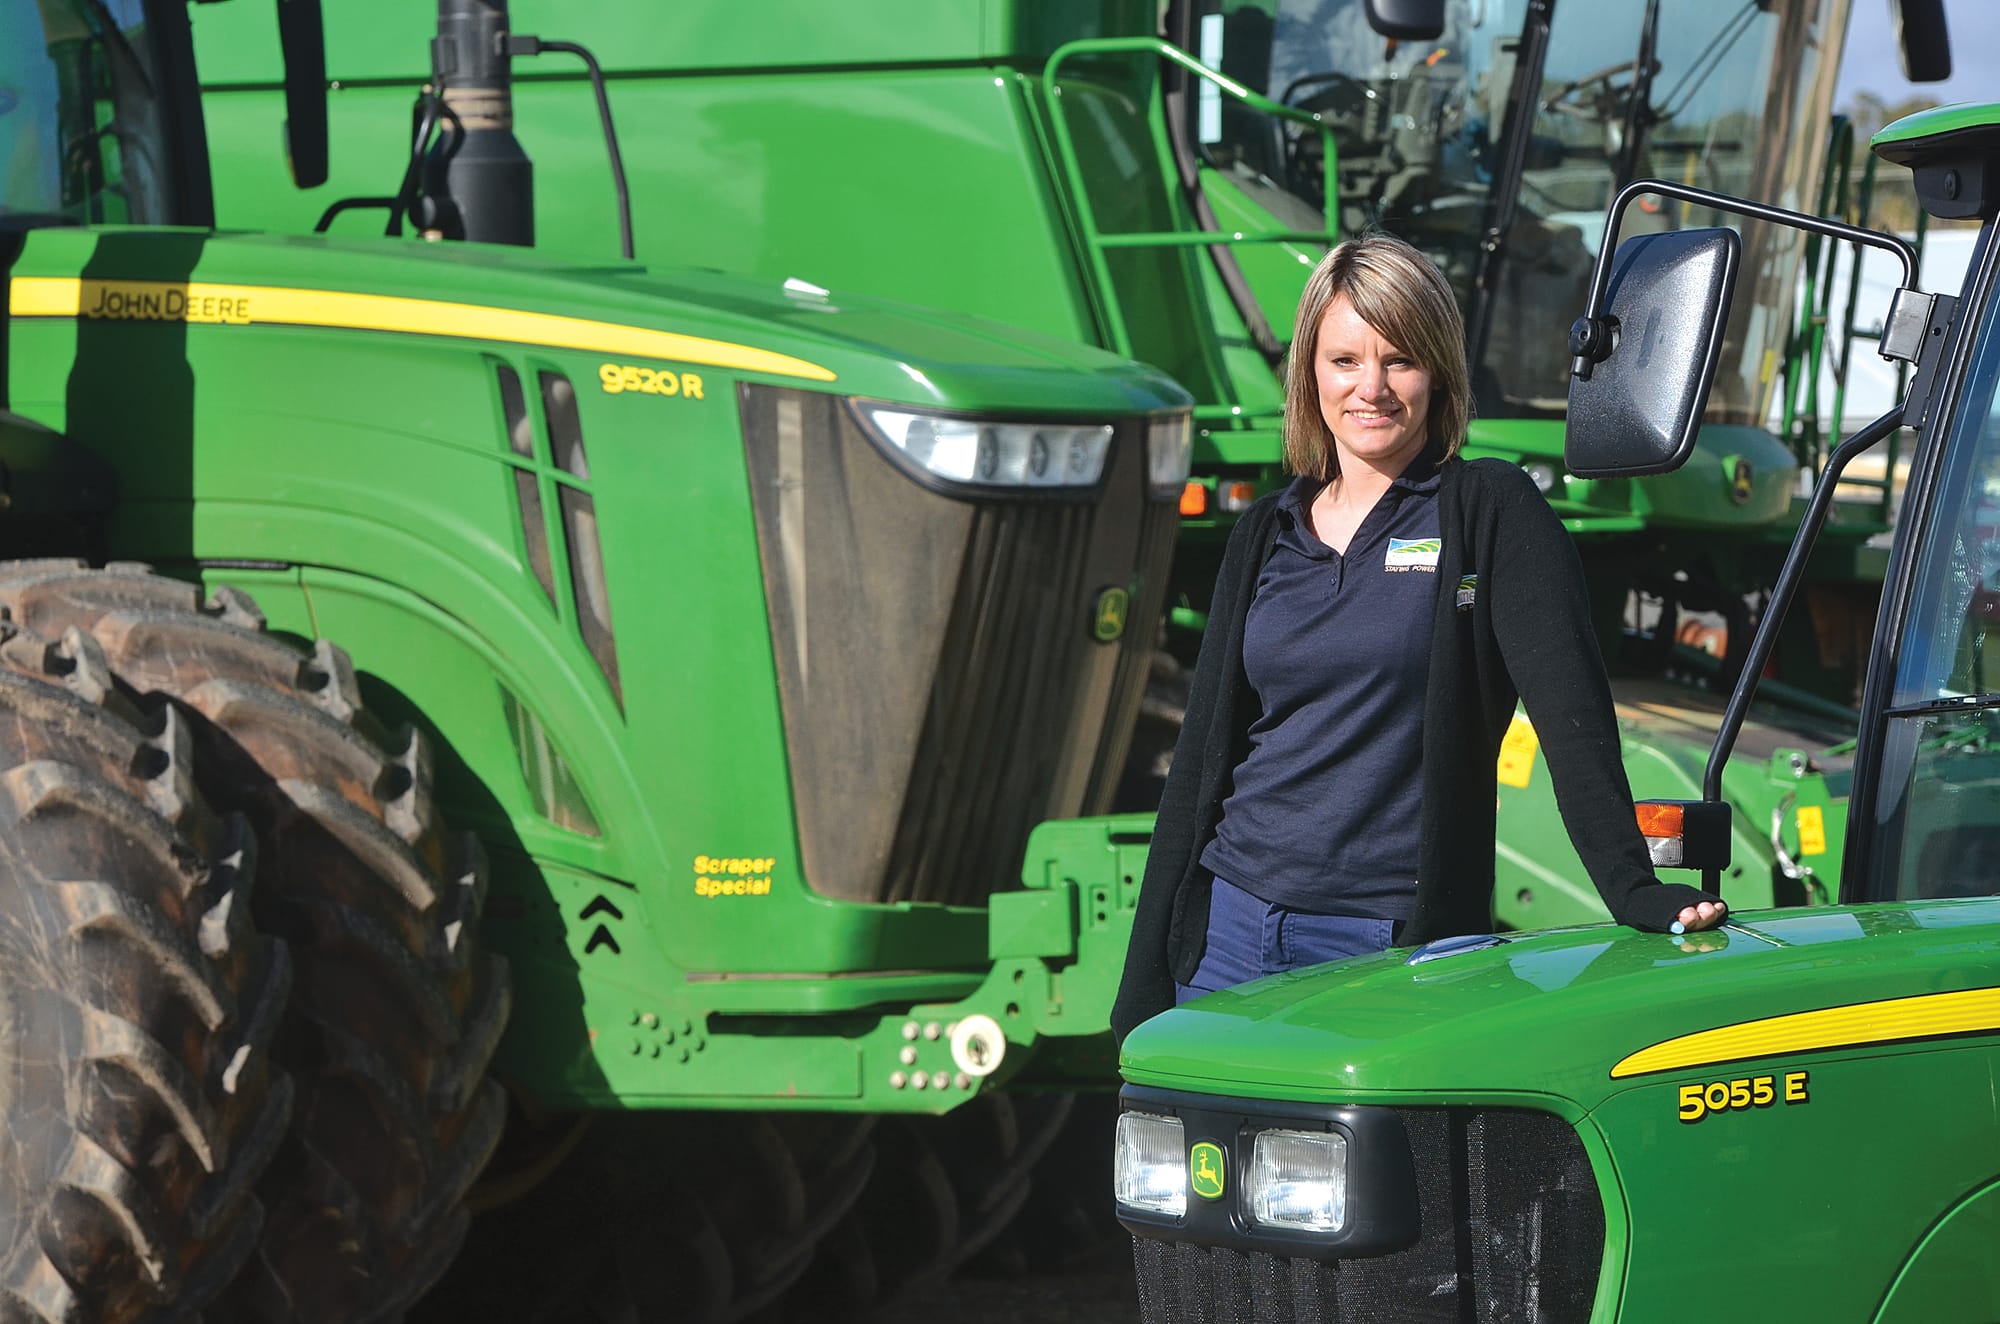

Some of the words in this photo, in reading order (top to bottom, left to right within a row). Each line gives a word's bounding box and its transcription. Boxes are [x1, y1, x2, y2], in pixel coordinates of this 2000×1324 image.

[91, 286, 161, 315] JOHN
[165, 288, 250, 319] DEERE
[599, 362, 680, 397] 9520
[681, 372, 705, 400] R
[1384, 565, 1410, 574] STAYING
[1411, 564, 1437, 574] POWER
[693, 854, 776, 877] Scraper
[694, 876, 772, 899] Special
[1679, 1076, 1776, 1123] 5055
[1785, 1071, 1809, 1105] E
